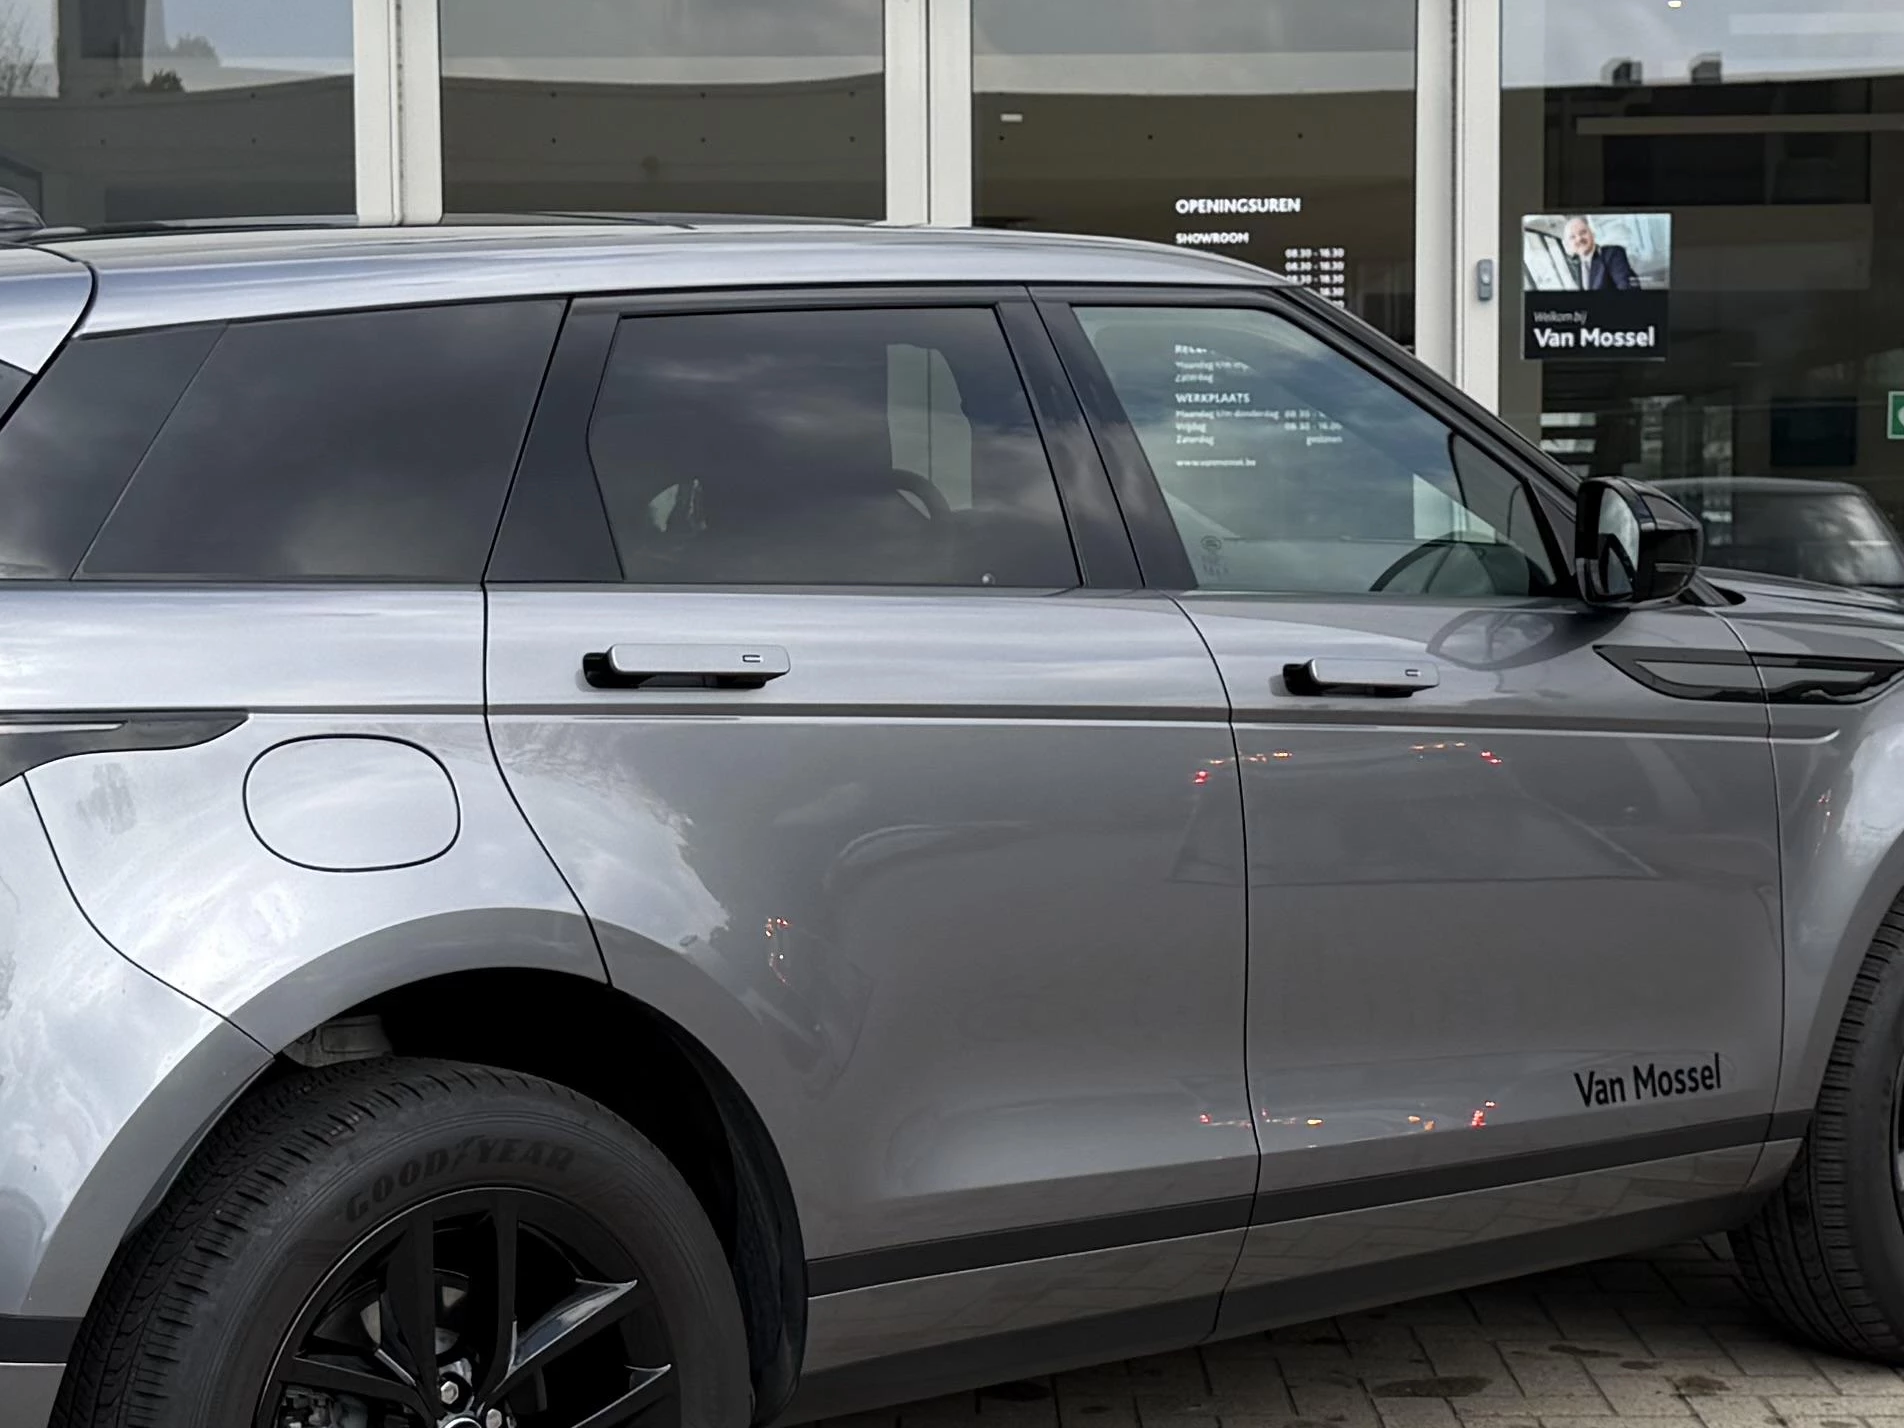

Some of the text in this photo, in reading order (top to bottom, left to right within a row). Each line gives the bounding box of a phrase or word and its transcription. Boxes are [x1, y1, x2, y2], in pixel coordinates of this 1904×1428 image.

[1175, 198, 1301, 213] OPENINGSUREN
[1175, 232, 1249, 244] SHOWROOM
[1533, 311, 1573, 323] Welkom
[1533, 326, 1656, 348] Van Mossel
[1175, 393, 1250, 403] WERKPLAATS
[1573, 1052, 1722, 1108] Van Mossel
[344, 1134, 575, 1222] GOODYEAR
